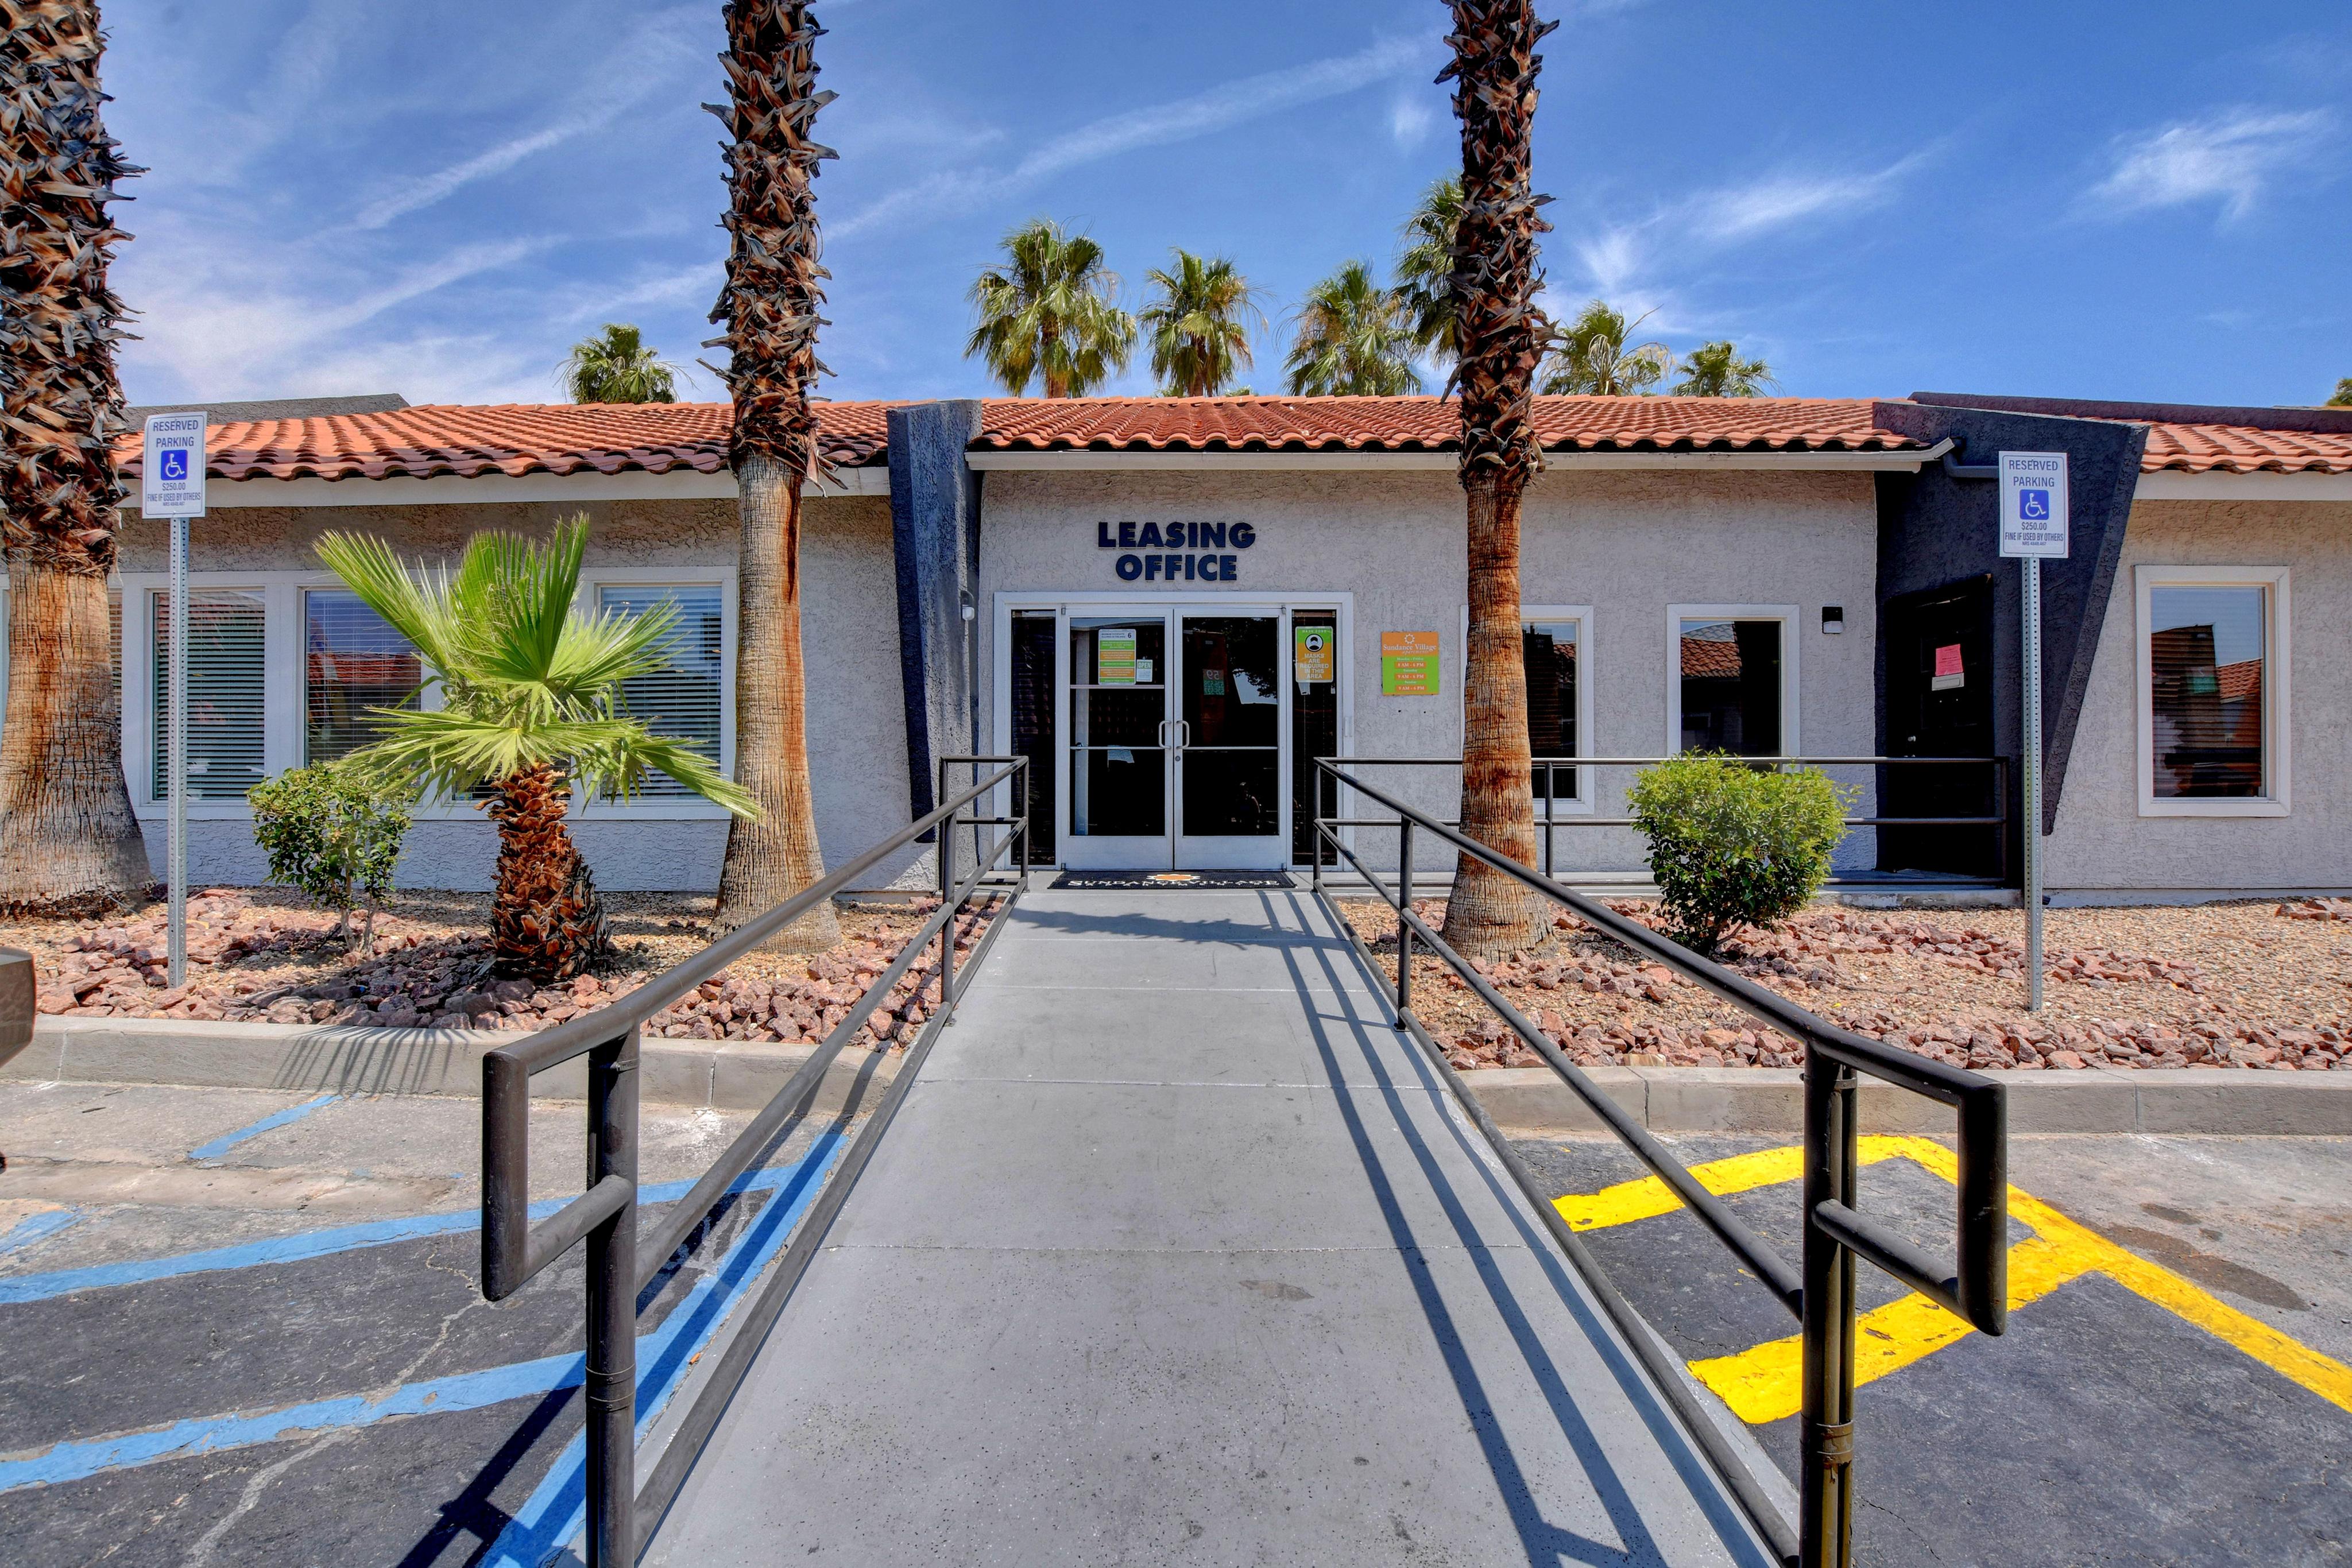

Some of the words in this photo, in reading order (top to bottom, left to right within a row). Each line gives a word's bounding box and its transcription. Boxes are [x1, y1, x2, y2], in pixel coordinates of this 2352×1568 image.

[153, 420, 198, 432] RESERVED
[156, 436, 194, 447] PARKING
[2009, 460, 2058, 471] RESERVED
[162, 482, 186, 491] $250.00
[2013, 477, 2055, 487] PARKING
[148, 494, 157, 502] FINE
[163, 493, 176, 501] USED
[177, 493, 183, 501] BY
[183, 492, 201, 501] OTHERS
[2022, 522, 2047, 531] $250.00
[1098, 521, 1256, 549] LEASING
[2005, 532, 2016, 540] FINE
[2017, 532, 2022, 540] IF
[2023, 533, 2036, 541] USED
[2037, 533, 2044, 541] BY
[2044, 533, 2064, 541] OTHERS
[1116, 554, 1237, 581] OFFICE
[1414, 644, 1436, 652] Village
